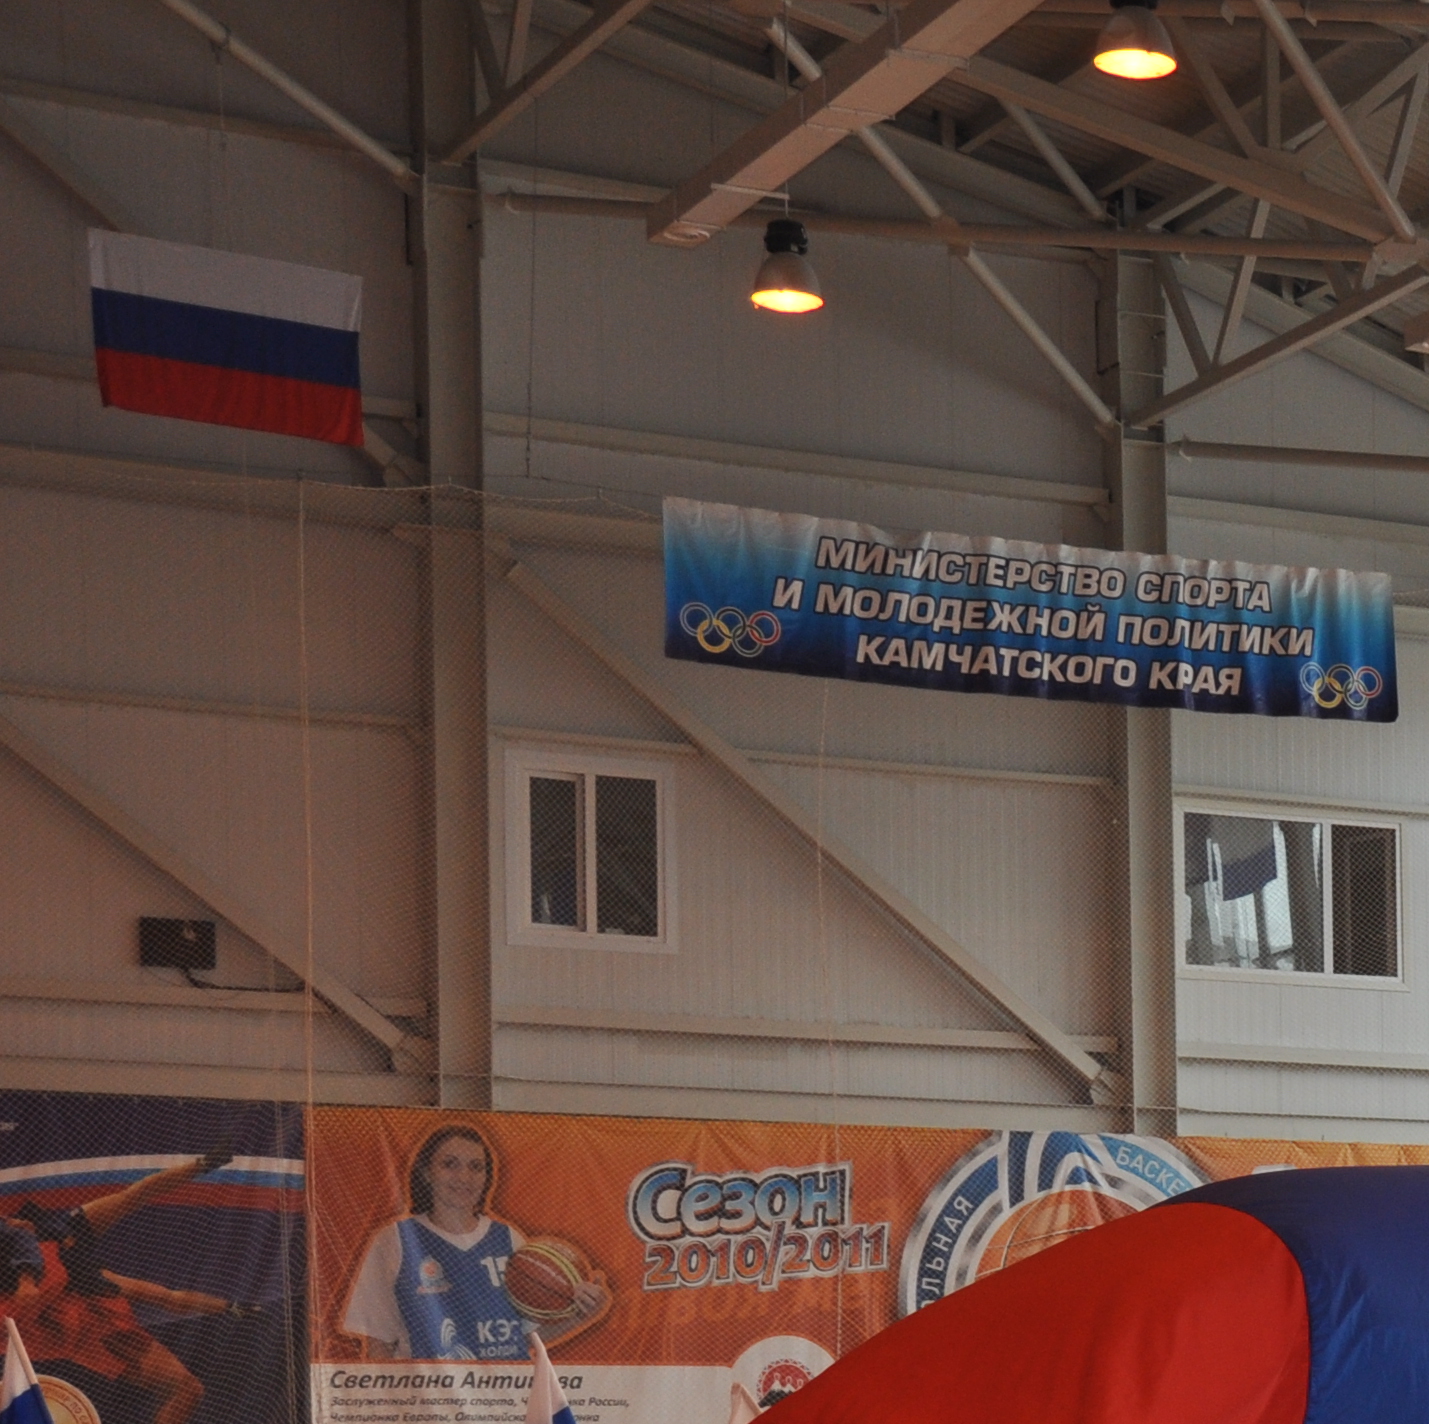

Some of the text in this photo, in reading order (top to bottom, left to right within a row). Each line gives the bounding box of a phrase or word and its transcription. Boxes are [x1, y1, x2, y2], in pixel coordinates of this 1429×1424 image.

[815, 535, 1273, 613] МИНИСТЕРСТВО СПОРТА
[771, 577, 1316, 659] И МОЛОДЕЖНОЙ ПОЛИТИКИ
[855, 630, 1244, 697] КАМЧАТСКОГО КРАЯ
[630, 1162, 850, 1243] Сезон
[1114, 1145, 1191, 1198] БАСКЕ
[643, 1220, 888, 1288] 2010/2011
[917, 1195, 975, 1308] ЛЬНАЯ
[330, 1370, 583, 1390] Светлана Антива
[330, 1396, 417, 1409] Заслуженный
[419, 1398, 467, 1410] мастер
[469, 1397, 517, 1409] спорта,
[588, 1396, 630, 1409] России,
[455, 1411, 526, 1423] Олимпийска
